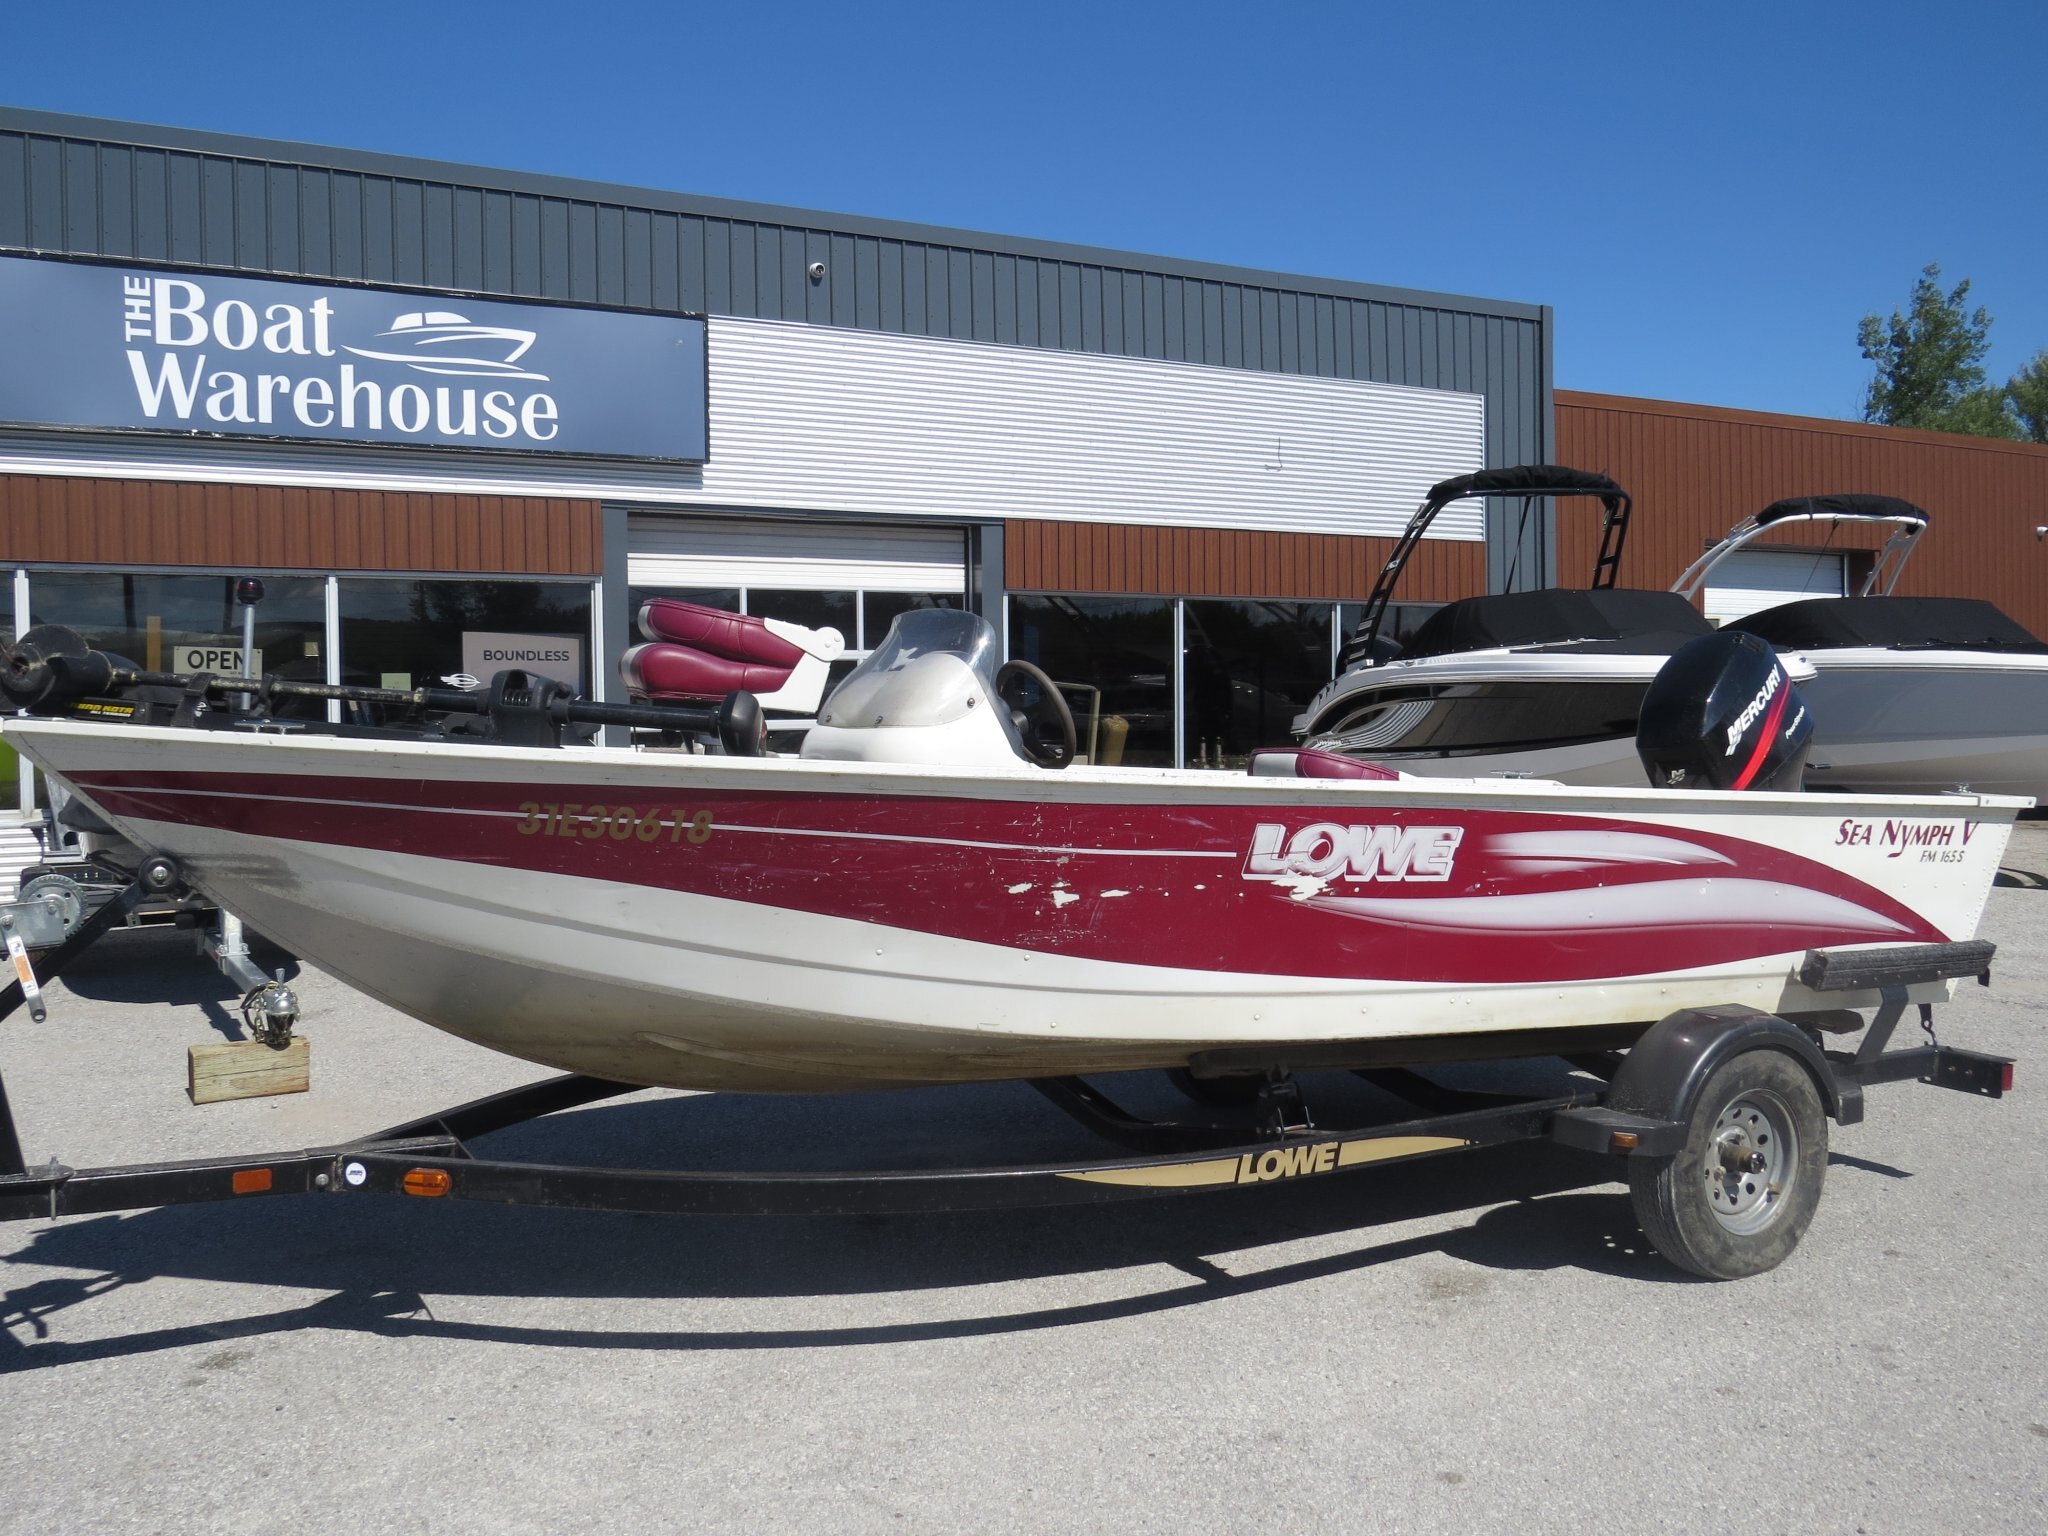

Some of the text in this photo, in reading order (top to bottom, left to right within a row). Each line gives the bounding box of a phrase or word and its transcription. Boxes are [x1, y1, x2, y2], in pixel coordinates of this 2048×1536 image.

[124, 276, 336, 356] THE Boat
[126, 350, 558, 440] Warehouse
[187, 650, 244, 670] OPEN
[483, 650, 570, 662] BOUNDLESS
[1725, 663, 1782, 757] MERCURY
[516, 801, 714, 844] 31E30618
[1835, 819, 1873, 846] SEA
[1962, 821, 1980, 846] V
[1241, 823, 1464, 883] LOWE
[1919, 850, 1938, 862] FM
[1238, 1141, 1338, 1184] LOWE
